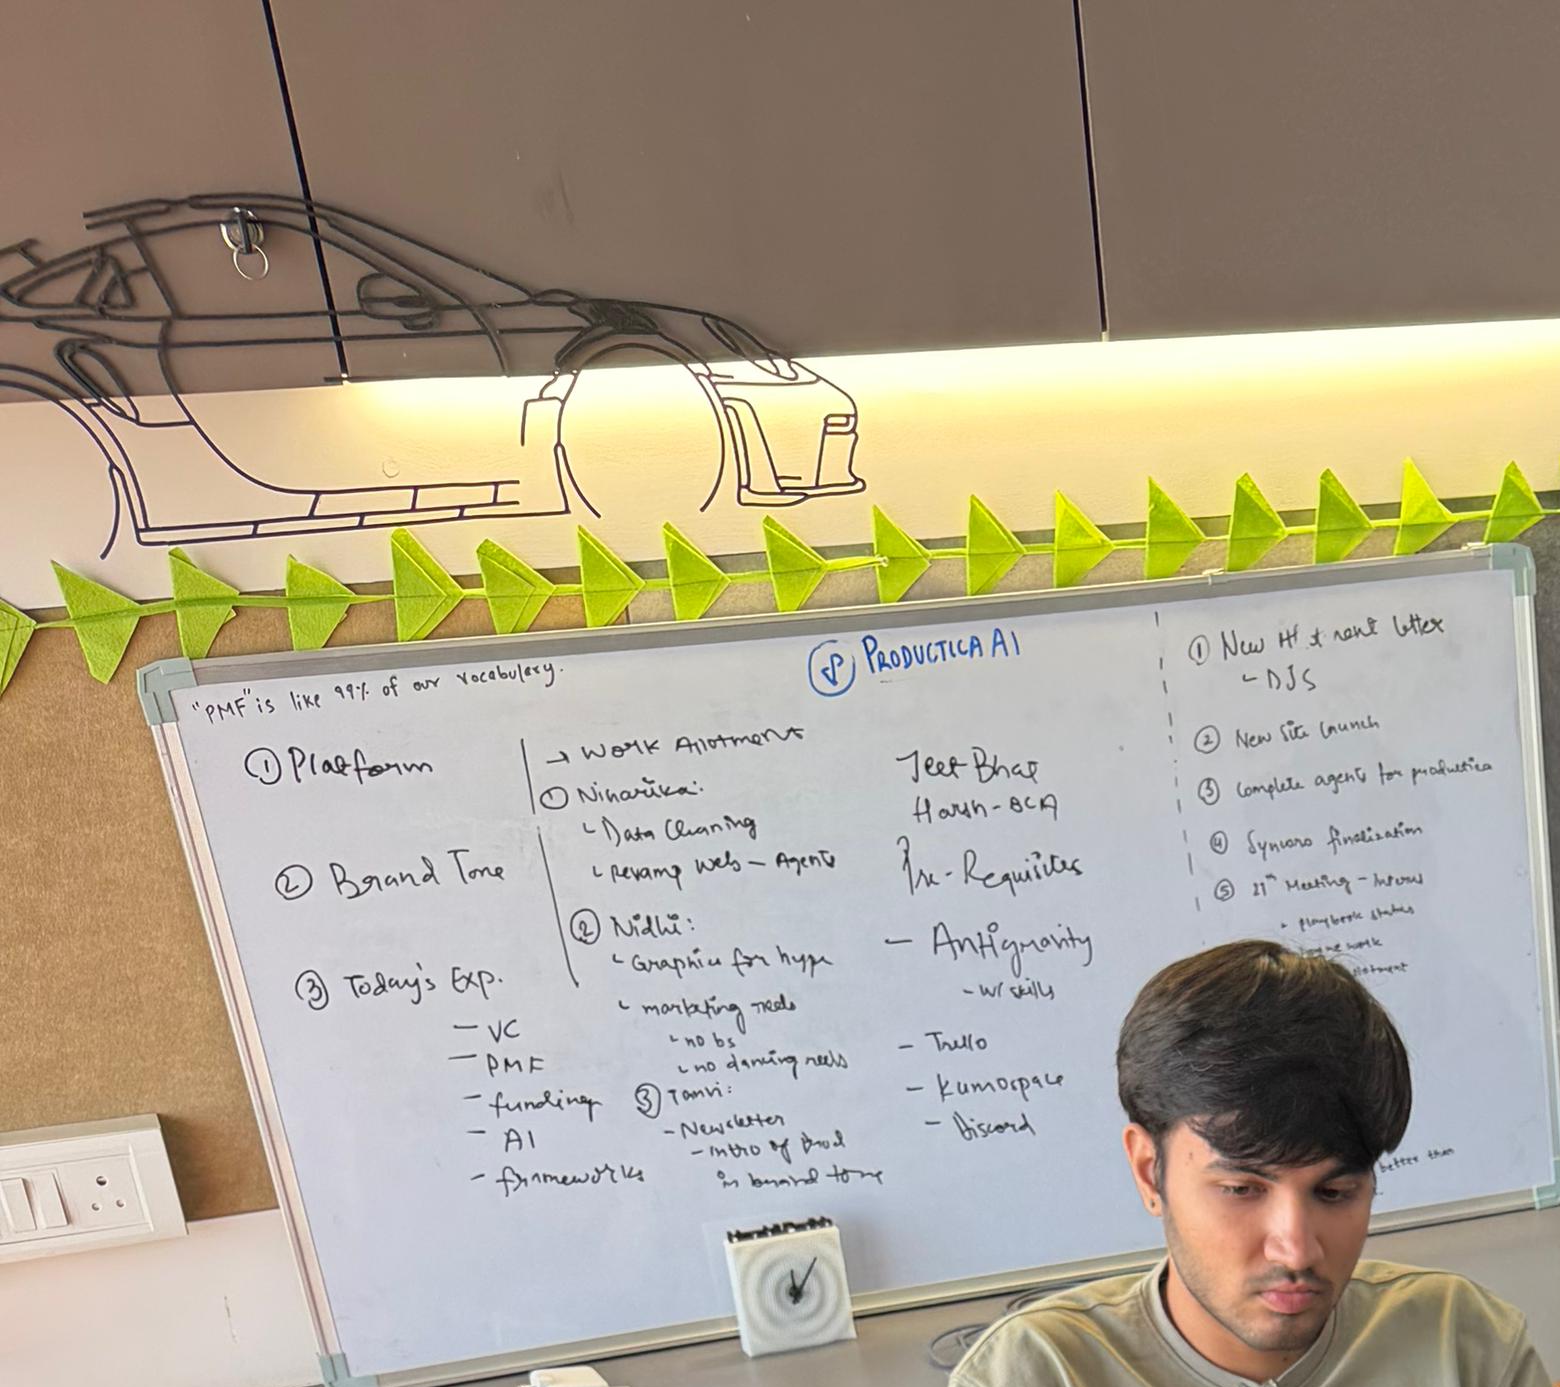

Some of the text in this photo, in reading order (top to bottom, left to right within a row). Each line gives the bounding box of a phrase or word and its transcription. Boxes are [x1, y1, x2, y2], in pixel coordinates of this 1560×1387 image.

[991, 628, 1020, 656] AI
[257, 698, 274, 713] is
[291, 692, 320, 712] like
[382, 678, 398, 697] of
[413, 678, 440, 691] our
[602, 815, 655, 847] Data
[330, 856, 440, 899] Brand
[447, 849, 505, 885] Tone
[732, 947, 769, 977] for
[488, 1019, 520, 1043] VC
[487, 1052, 545, 1077] PMF
[505, 1128, 535, 1152] AI
